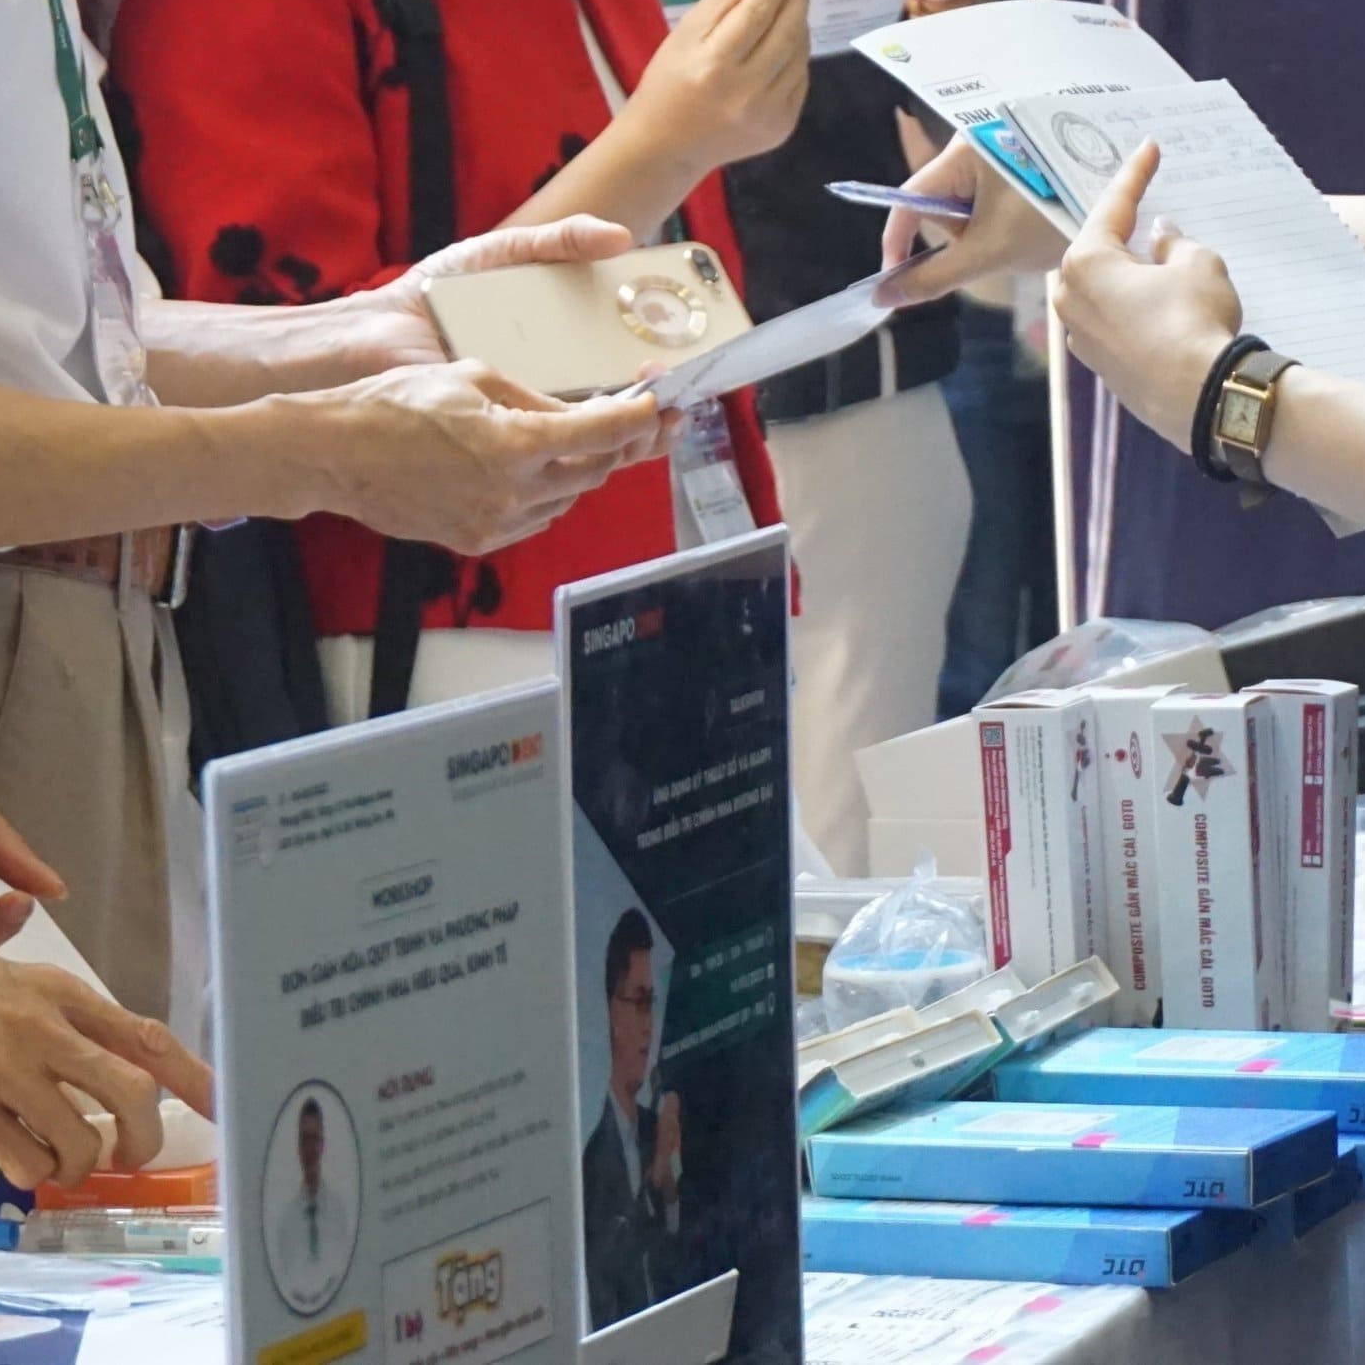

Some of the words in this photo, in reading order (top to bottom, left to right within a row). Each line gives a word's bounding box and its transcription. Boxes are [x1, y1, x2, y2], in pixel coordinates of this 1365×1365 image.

[1194, 813, 1210, 885] COMPOSITE
[1129, 921, 1147, 991] COMPOSITE
[1185, 1179, 1225, 1199] DTC
[1102, 1257, 1146, 1276] DTC
